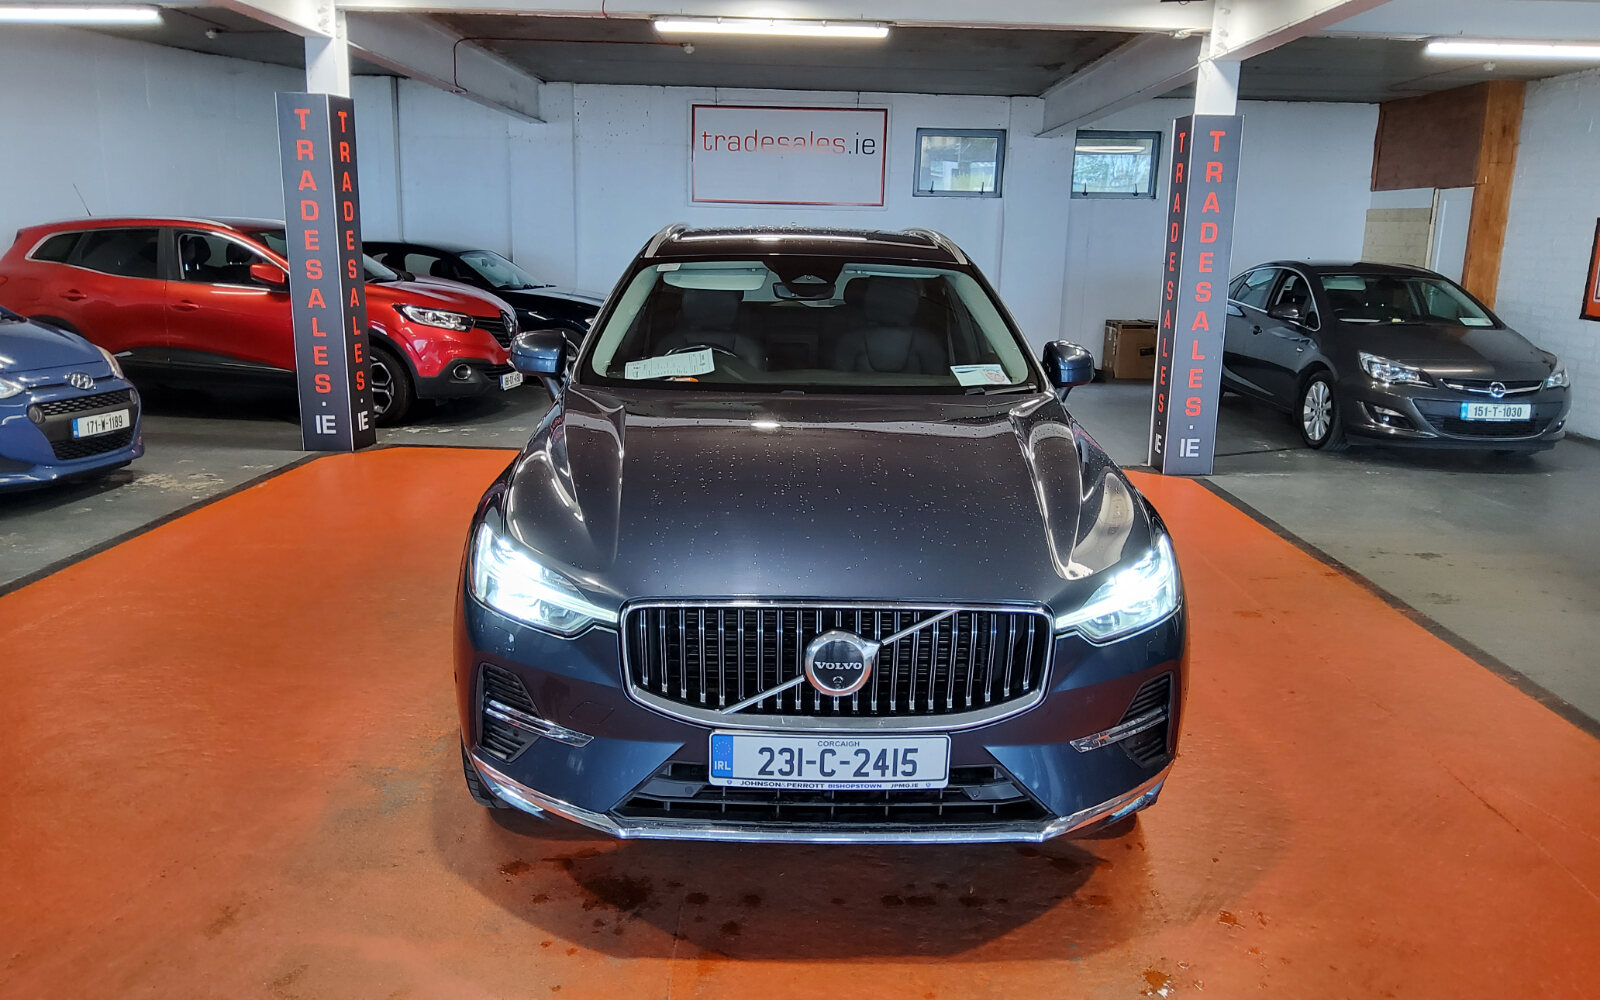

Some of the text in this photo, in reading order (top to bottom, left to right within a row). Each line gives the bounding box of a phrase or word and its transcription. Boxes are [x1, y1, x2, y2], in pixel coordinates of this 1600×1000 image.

[702, 128, 876, 155] tradesales.ie
[1474, 406, 1523, 417] 151-T-1030
[87, 415, 123, 434] 171-W-1189
[814, 661, 862, 670] VOLVO
[714, 760, 731, 770] IRL
[757, 746, 919, 777] 231-C-2415
